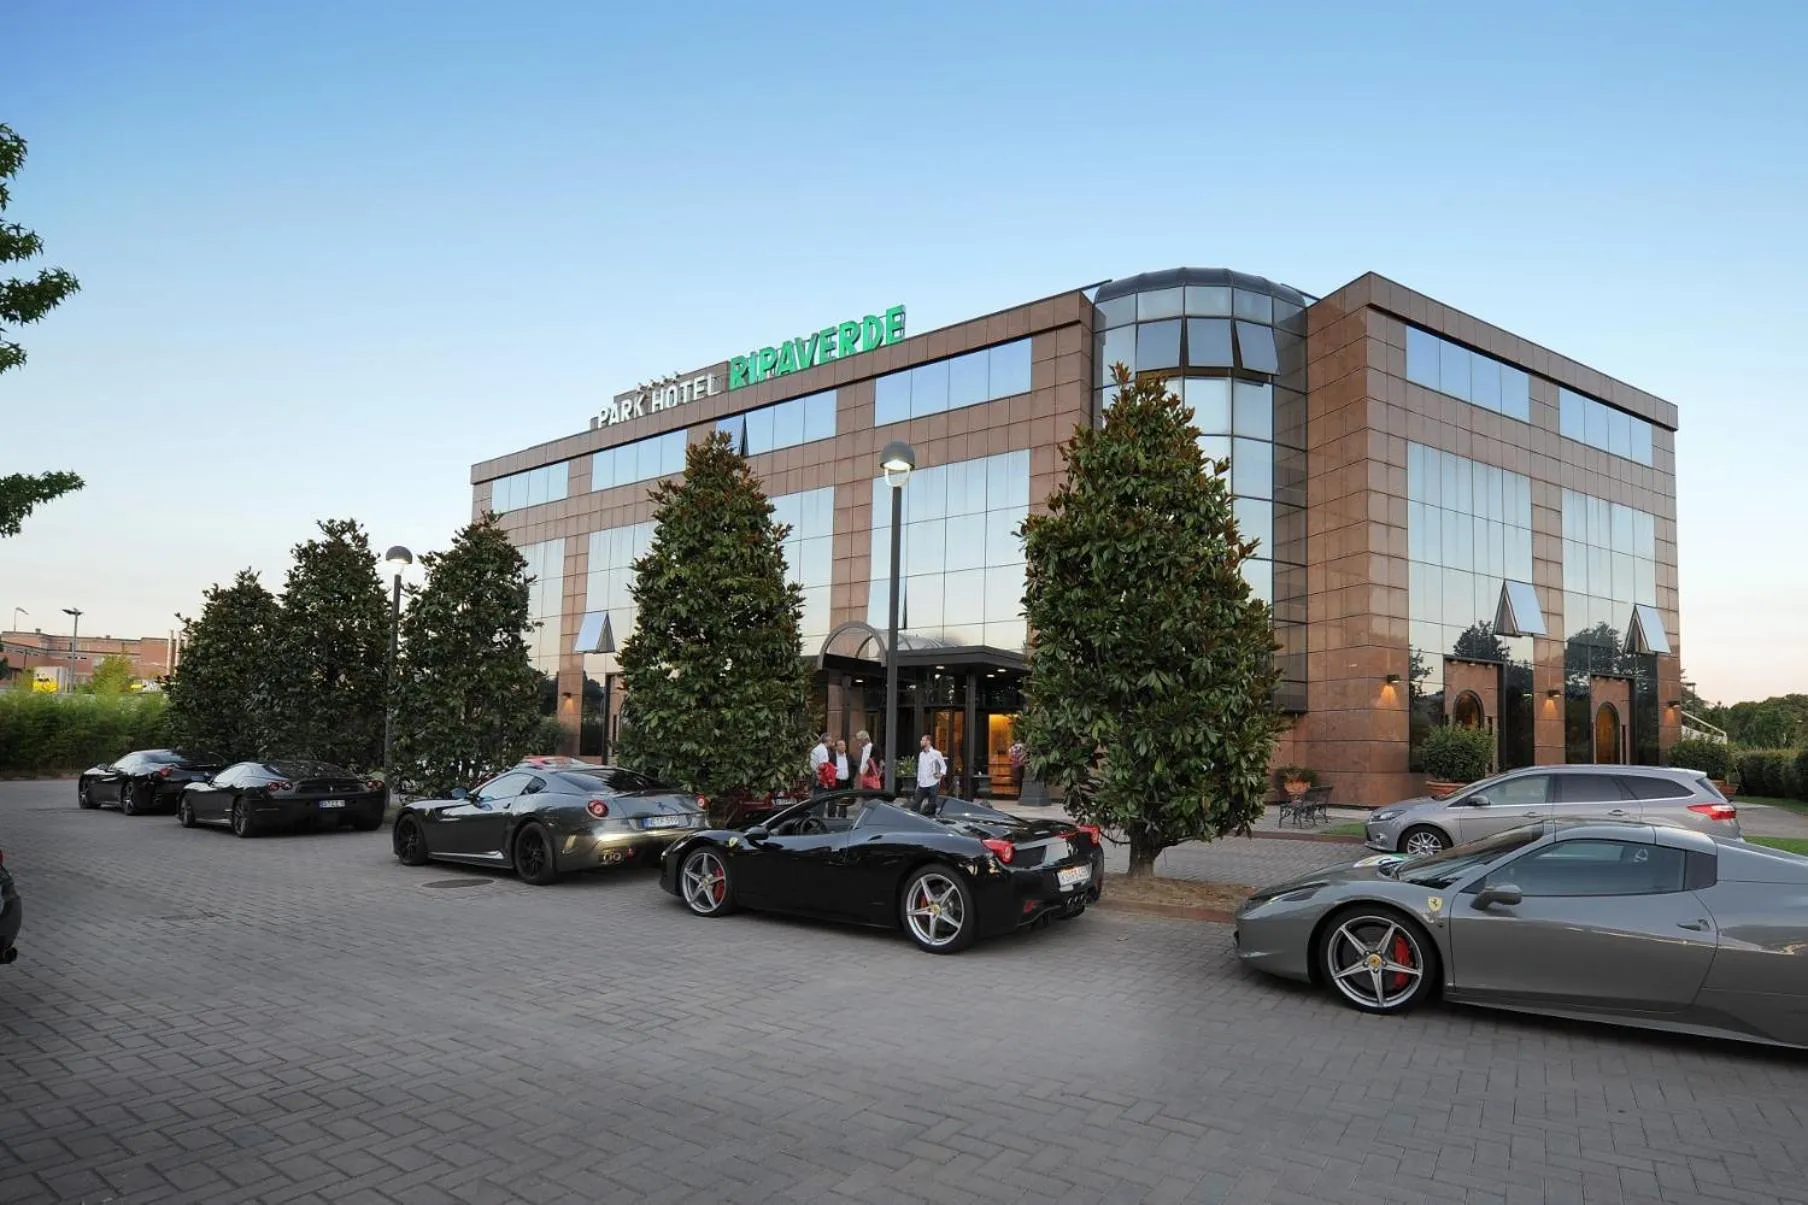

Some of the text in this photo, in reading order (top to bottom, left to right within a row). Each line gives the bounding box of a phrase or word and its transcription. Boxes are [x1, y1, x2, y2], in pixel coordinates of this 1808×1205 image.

[597, 304, 906, 429] PARK HOTEL RIPAVERDE
